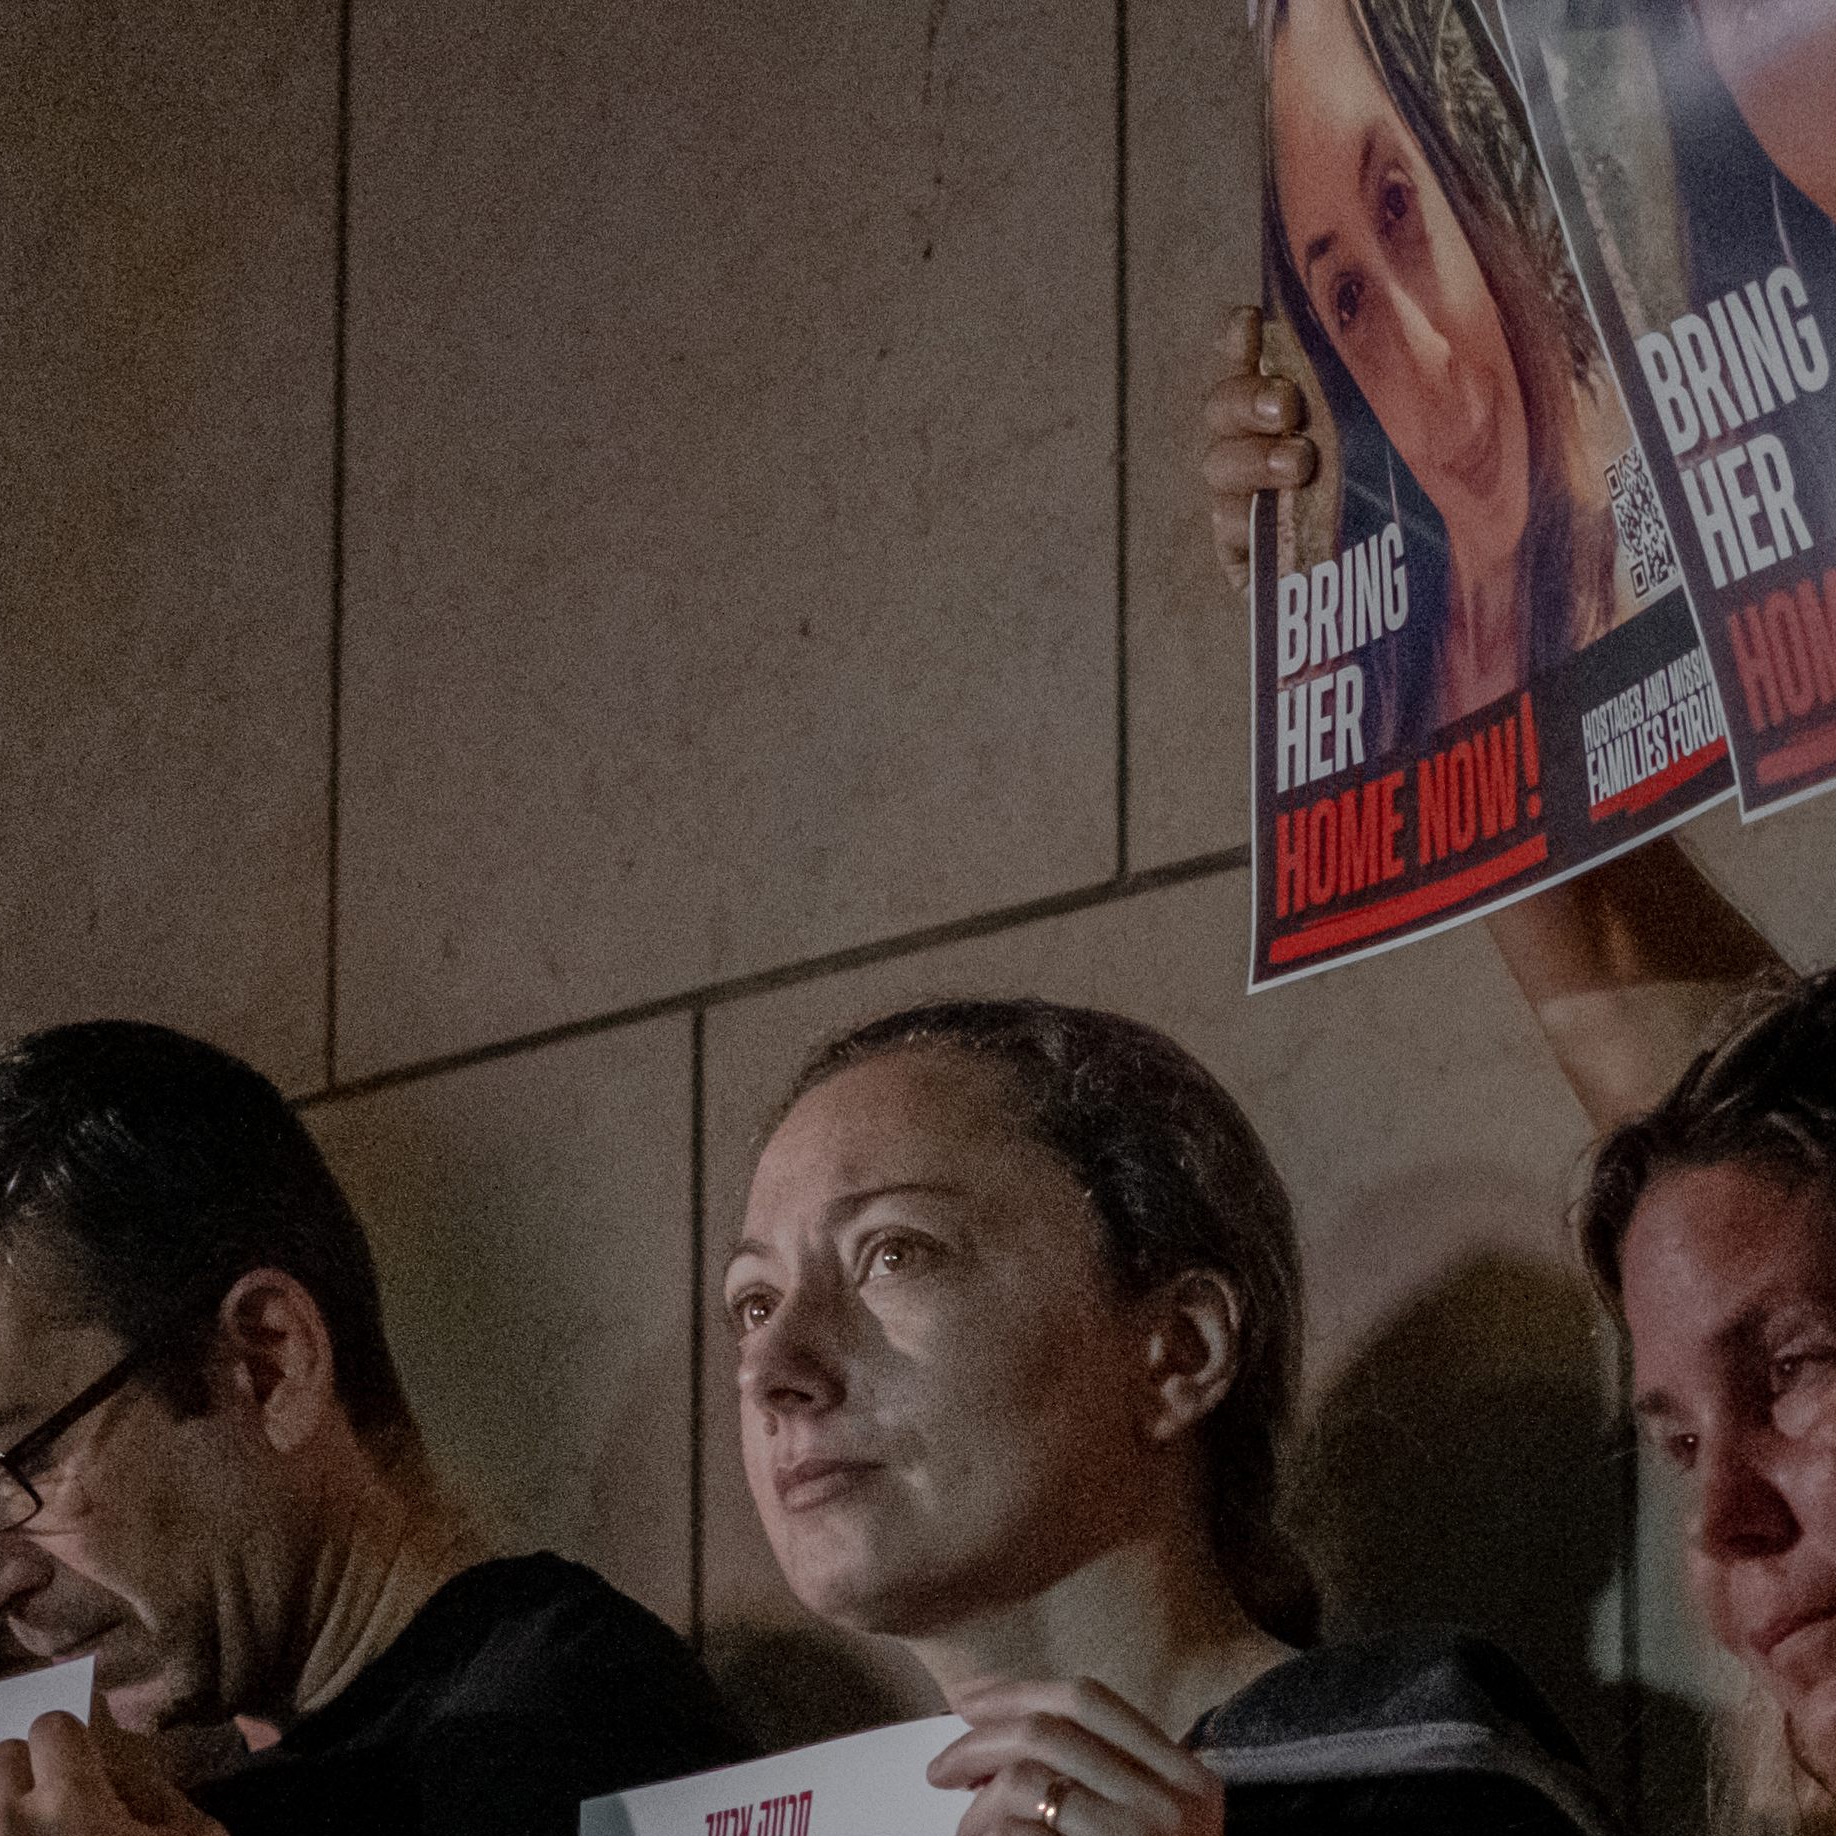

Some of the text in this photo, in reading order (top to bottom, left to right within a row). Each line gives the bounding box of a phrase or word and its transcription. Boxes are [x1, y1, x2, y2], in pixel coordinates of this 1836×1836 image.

[1636, 265, 1829, 456] BRING
[1680, 433, 1814, 590] HER
[1276, 521, 1409, 678] BRING
[1276, 664, 1365, 794] HER
[1582, 683, 1644, 753] HOSTAGES
[1644, 669, 1671, 719] AND
[1587, 714, 1669, 806] FAMILIES
[1276, 692, 1541, 918] HOME NOW!
